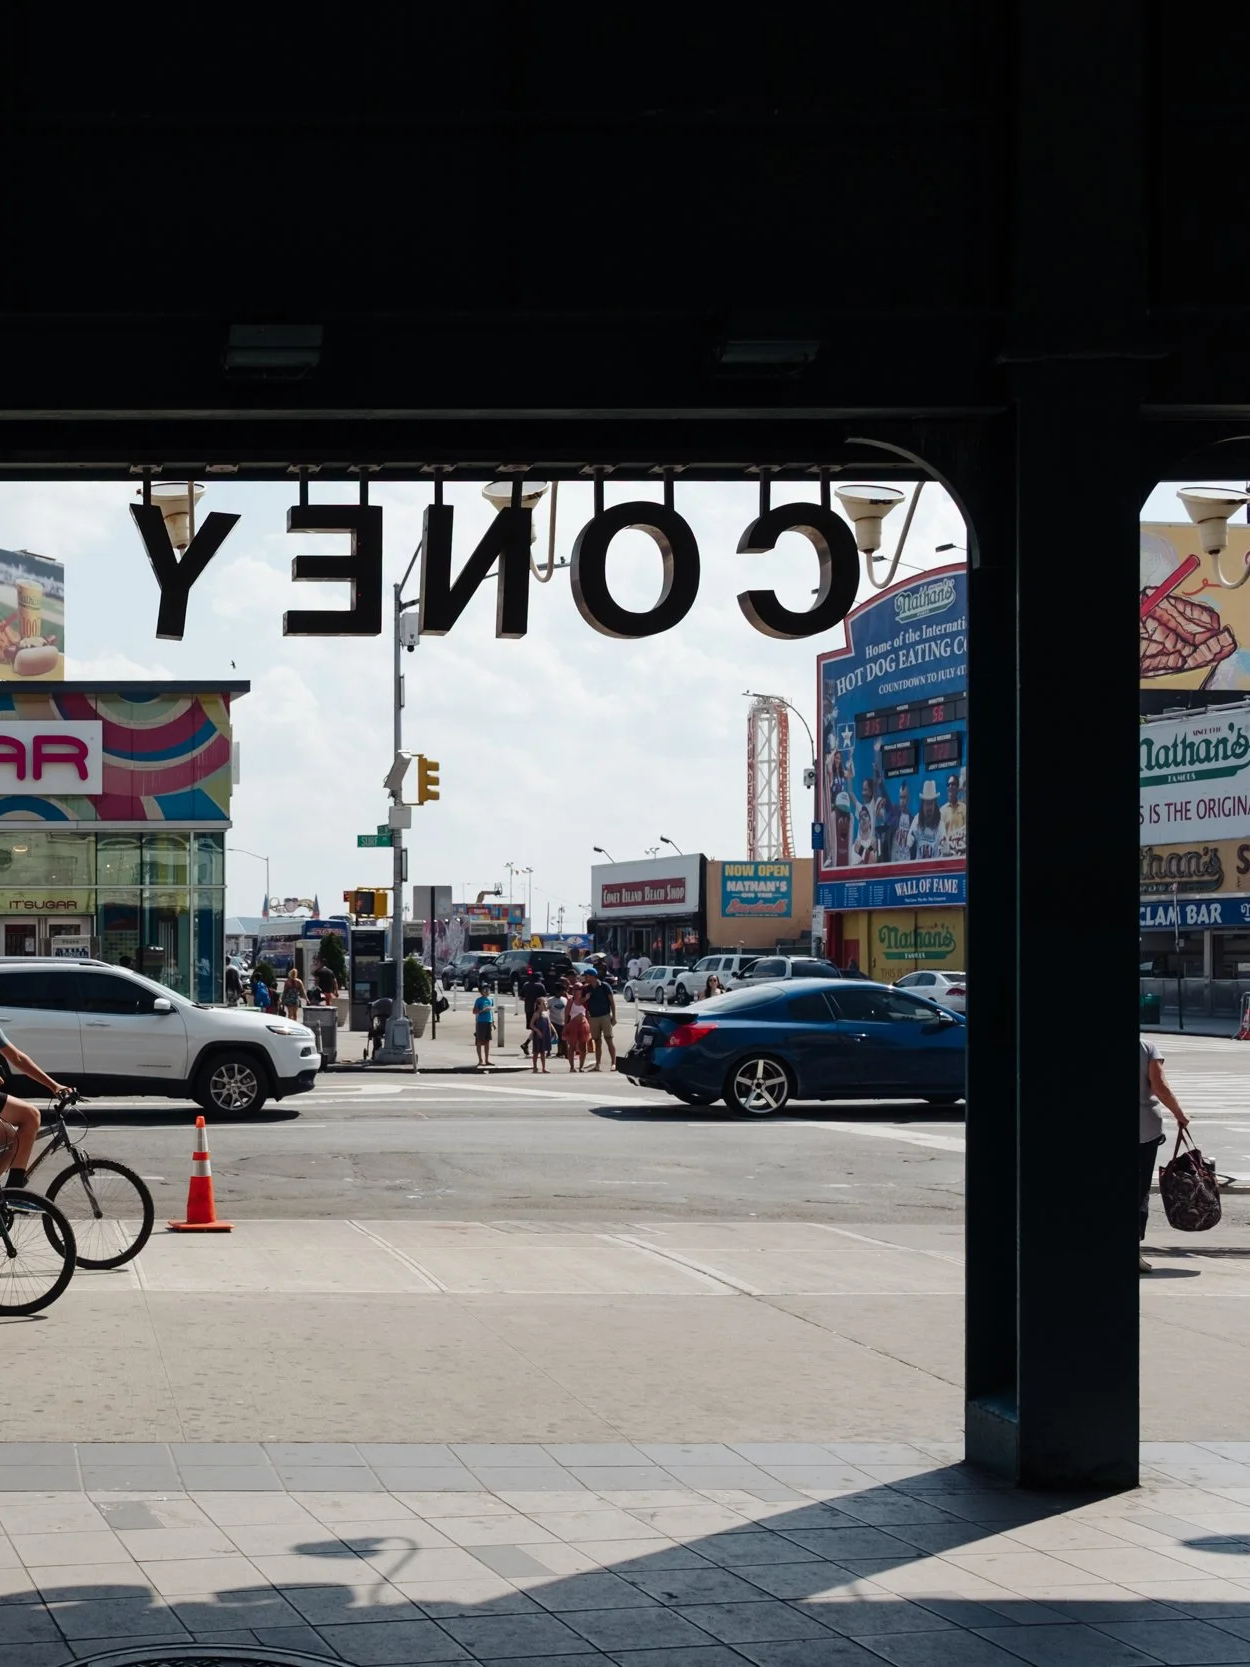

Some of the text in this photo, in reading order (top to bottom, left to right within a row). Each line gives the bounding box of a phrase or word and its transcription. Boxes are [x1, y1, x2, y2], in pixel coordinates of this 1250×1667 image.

[865, 615, 966, 659] Home of the Internati
[836, 666, 864, 697] HOT
[866, 653, 896, 682] DOG
[899, 638, 951, 669] EATING
[878, 678, 926, 695] COUNTDOWN
[927, 672, 937, 684] TO
[938, 667, 956, 682] JULY
[1167, 773, 1196, 783] FAMOUS
[1149, 803, 1161, 825] IS
[1165, 800, 1192, 822] THE
[1196, 795, 1250, 820] ORIGIN
[725, 864, 789, 877] NOW OPEN
[667, 884, 685, 900] SHOP
[726, 880, 788, 892] NATHAN'S
[894, 880, 918, 897] WALL
[919, 878, 931, 894] OF
[933, 879, 958, 894] FAME
[9, 900, 77, 909] IT'SUGAR
[1185, 903, 1223, 925] BAR
